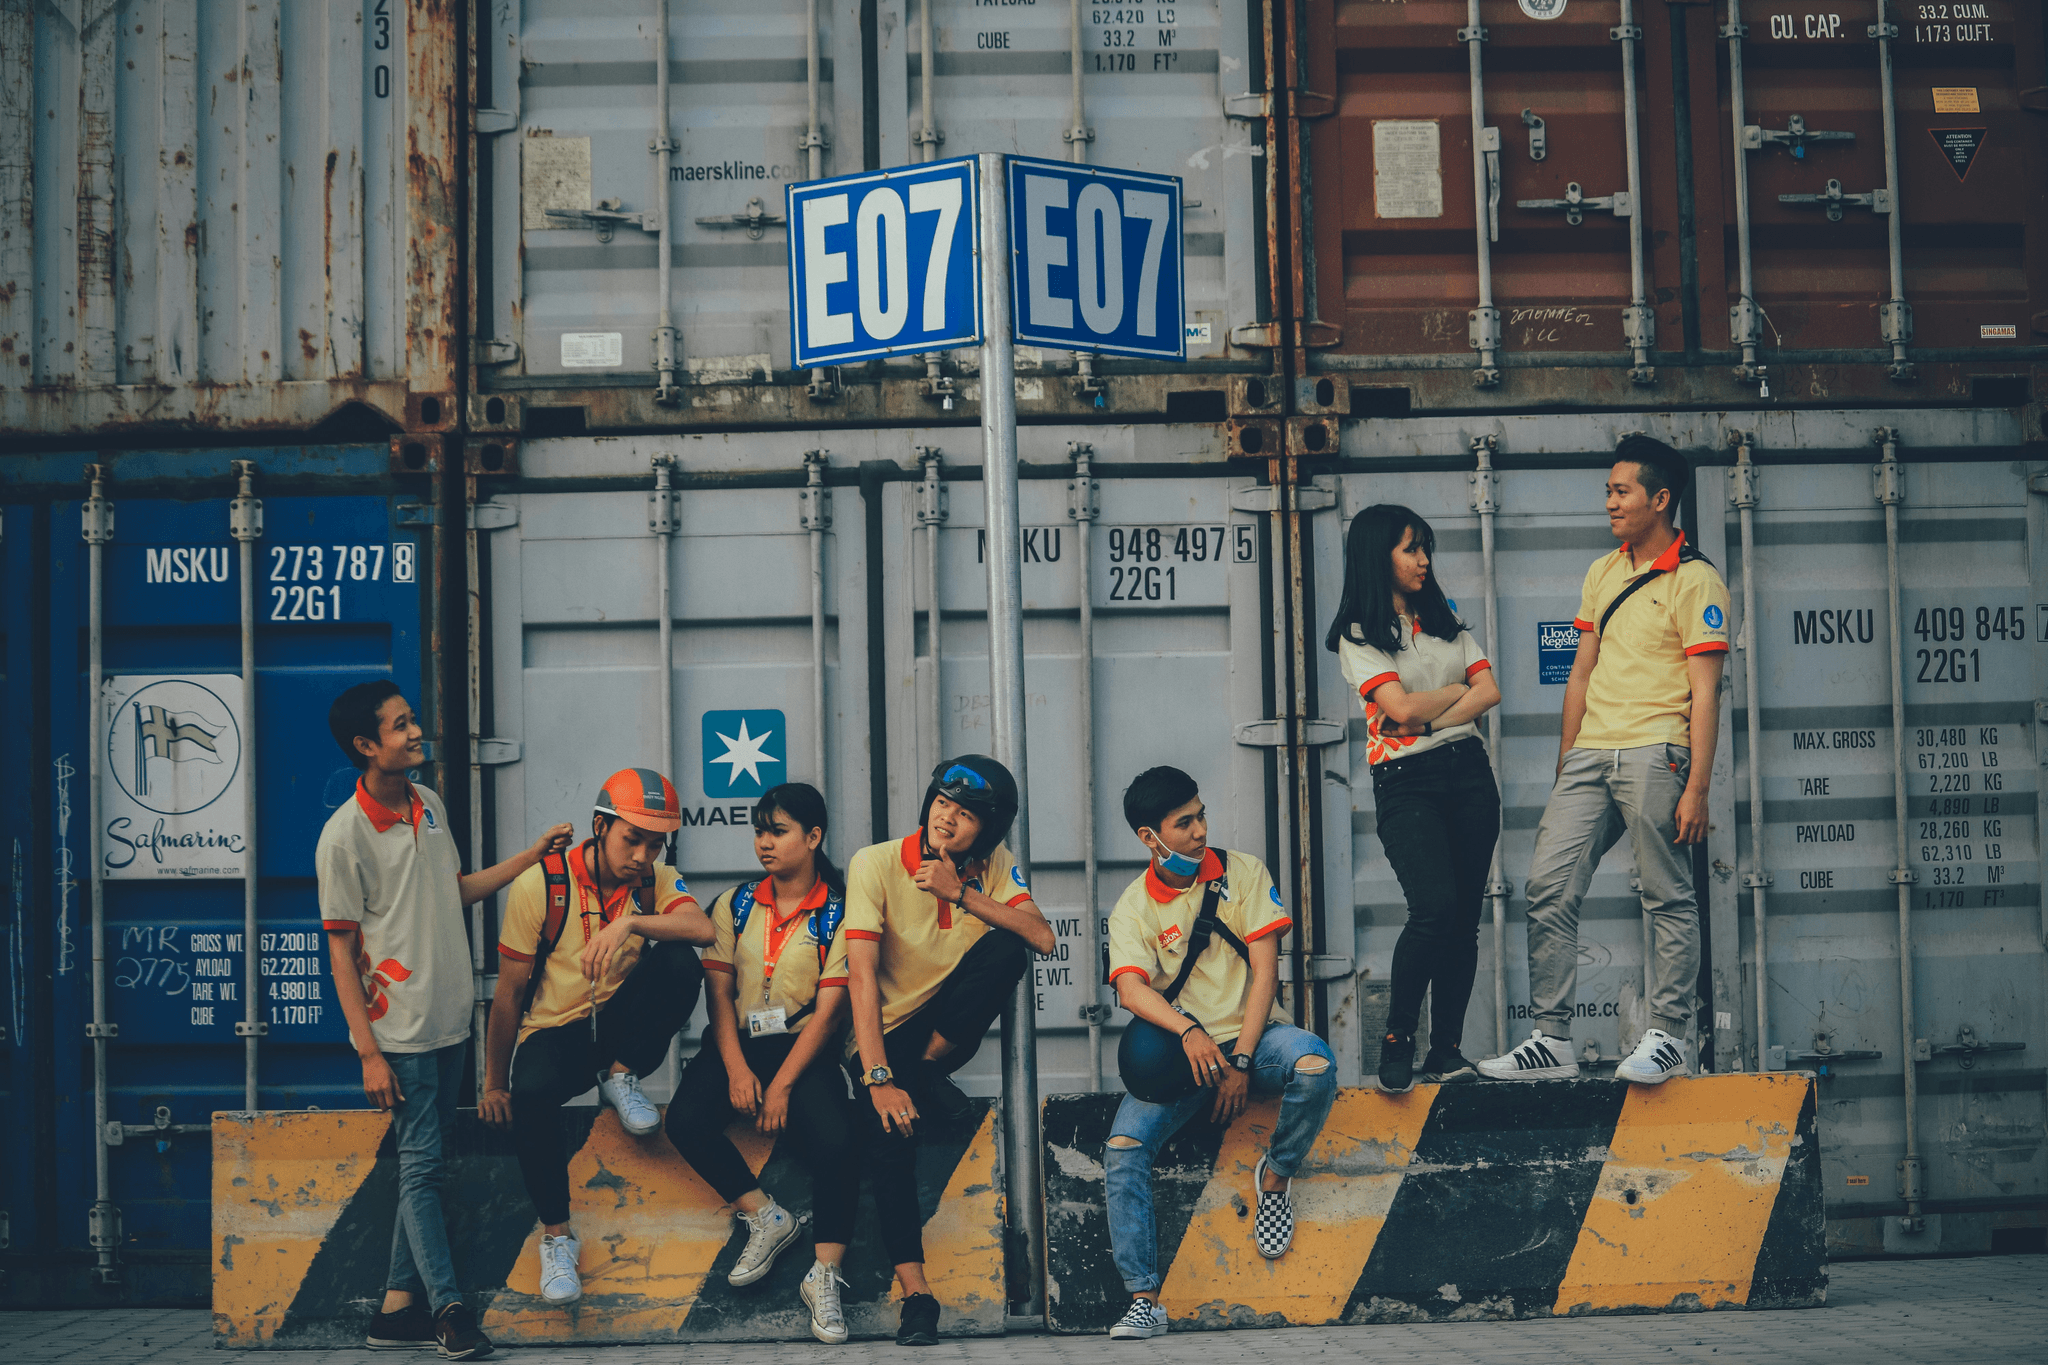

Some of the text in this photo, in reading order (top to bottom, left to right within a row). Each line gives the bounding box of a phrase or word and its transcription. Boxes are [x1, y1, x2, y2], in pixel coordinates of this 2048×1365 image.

[1092, 9, 1175, 24] 62.420 LB
[1918, 4, 1989, 20] 33.2 CU.M.
[1770, 14, 1845, 39] CU. CAP.
[1915, 24, 1951, 43] 1.173
[977, 31, 1010, 49] CUBE
[1103, 29, 1135, 47] 33.2
[1095, 53, 1136, 72] 1.170
[669, 160, 800, 181] maerskline.co
[802, 177, 963, 349] E07
[1024, 173, 1170, 338] E07
[1186, 327, 1208, 337] MC
[1981, 327, 2015, 336] SINGAMAS
[977, 526, 1252, 564] KU 948 497 5
[146, 545, 412, 583] MSKU 273 787 8
[1109, 566, 1176, 601] 22G1
[270, 585, 340, 621] 22G1
[1544, 626, 1579, 639] Lloyd's
[1793, 609, 1874, 645] MSKU
[1913, 606, 1965, 642] 409
[1975, 606, 2025, 641] 845
[1916, 648, 1980, 683] 22G1
[1793, 727, 1998, 750] MAX. GROSS 30,480 KG
[1918, 751, 1999, 770] 67,200 LB
[1797, 773, 2003, 796] TARE 2,220 KG
[682, 806, 757, 827] MAE
[1928, 797, 2000, 816] 4,890 LB
[1796, 819, 2002, 843] PAYLOAD 28,260 KG
[104, 817, 246, 869] Safmarine
[1921, 843, 2002, 863] 62,310 LB
[156, 865, 240, 875] www.safmarine.com
[1800, 870, 1834, 889] CUBE
[1933, 866, 1965, 885] 33.2
[1925, 890, 1964, 910] 1,170
[1055, 918, 1082, 937] WT.
[190, 933, 222, 952] GROSS
[226, 933, 244, 952] WT.
[260, 933, 305, 952] 67.200
[195, 958, 231, 977] AYLOAD
[260, 957, 306, 976] 62.220
[1046, 967, 1073, 986] WT.
[191, 982, 214, 1001] TARE
[219, 982, 238, 1001] WT.
[268, 981, 306, 1000] 4.980
[191, 1006, 215, 1025] CUBE
[270, 1005, 306, 1024] 1.170
